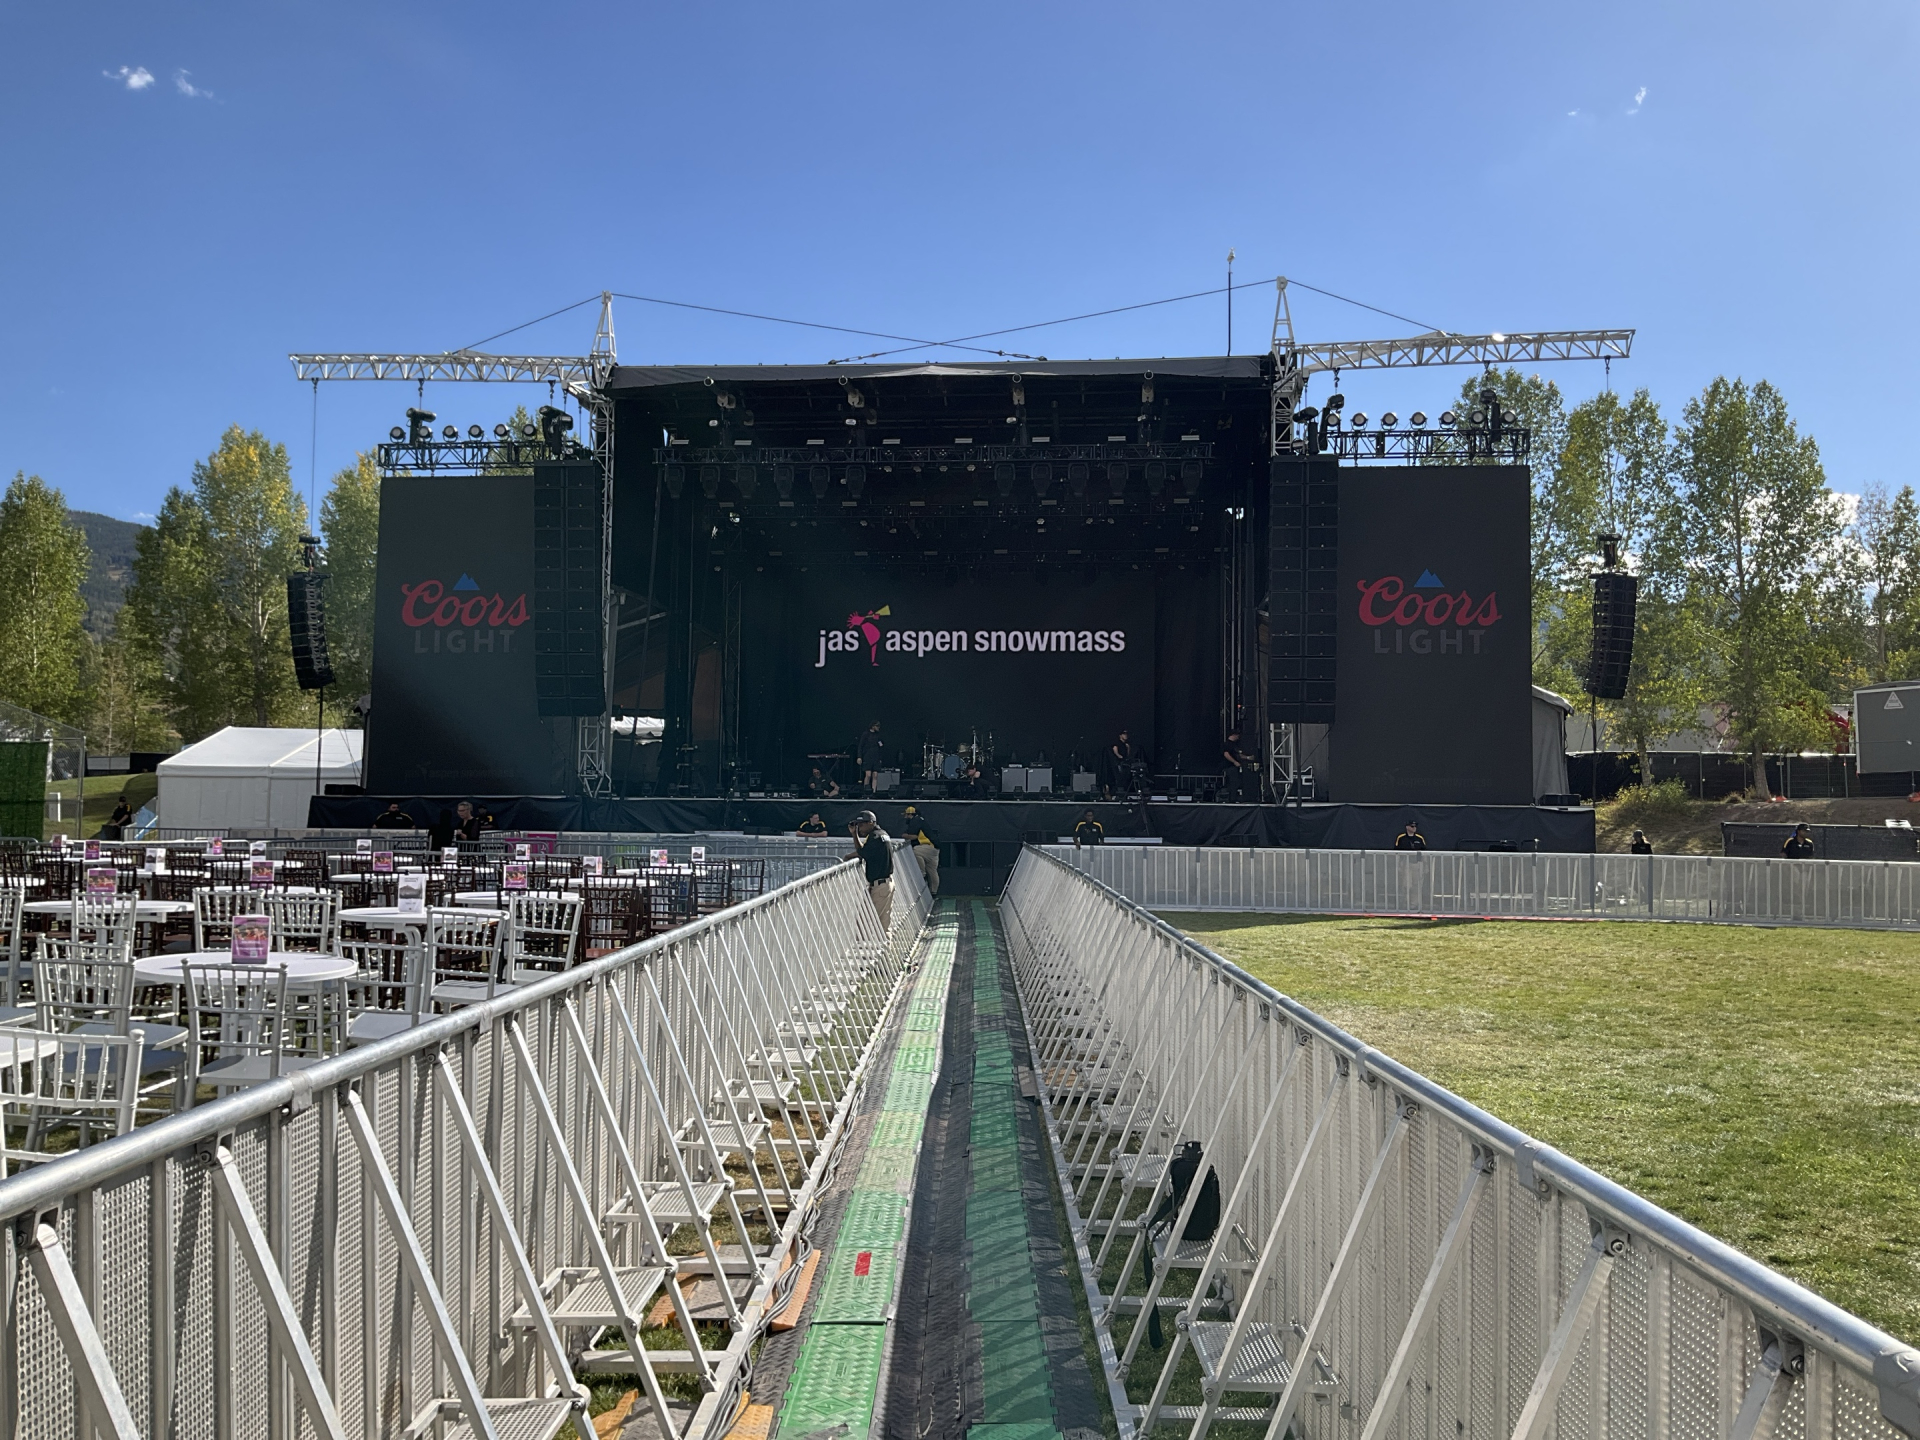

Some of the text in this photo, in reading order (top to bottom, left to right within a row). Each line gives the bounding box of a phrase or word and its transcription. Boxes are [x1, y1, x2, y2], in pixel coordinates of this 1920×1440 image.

[401, 579, 530, 627] Coors
[1356, 575, 1503, 626] Coors
[414, 629, 516, 654] LIGHT
[814, 629, 1126, 668] jas aspen snowmass
[1373, 628, 1487, 655] LIGHT
